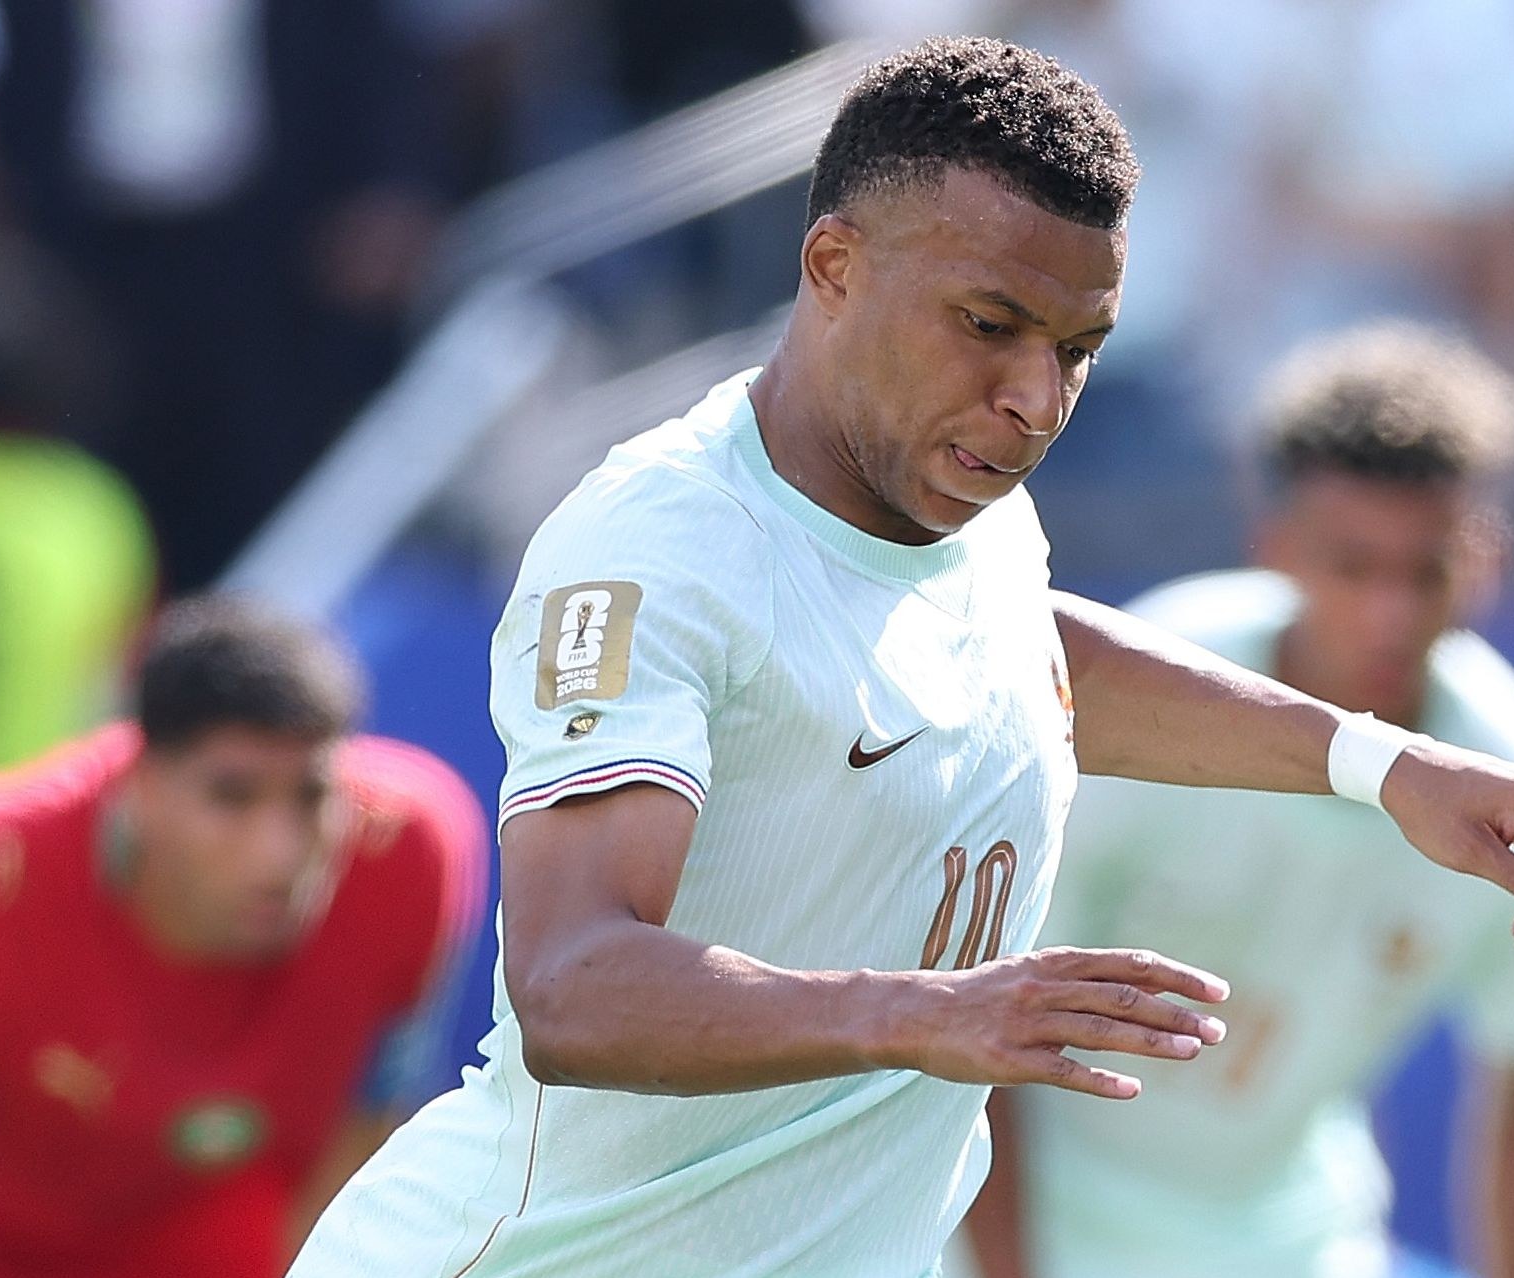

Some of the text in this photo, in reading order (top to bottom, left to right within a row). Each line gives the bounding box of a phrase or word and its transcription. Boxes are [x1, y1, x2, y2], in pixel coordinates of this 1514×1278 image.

[568, 652, 588, 662] FIFA
[556, 668, 598, 684] WORLD CUP
[556, 678, 597, 698] 2026
[919, 840, 1018, 970] 10
